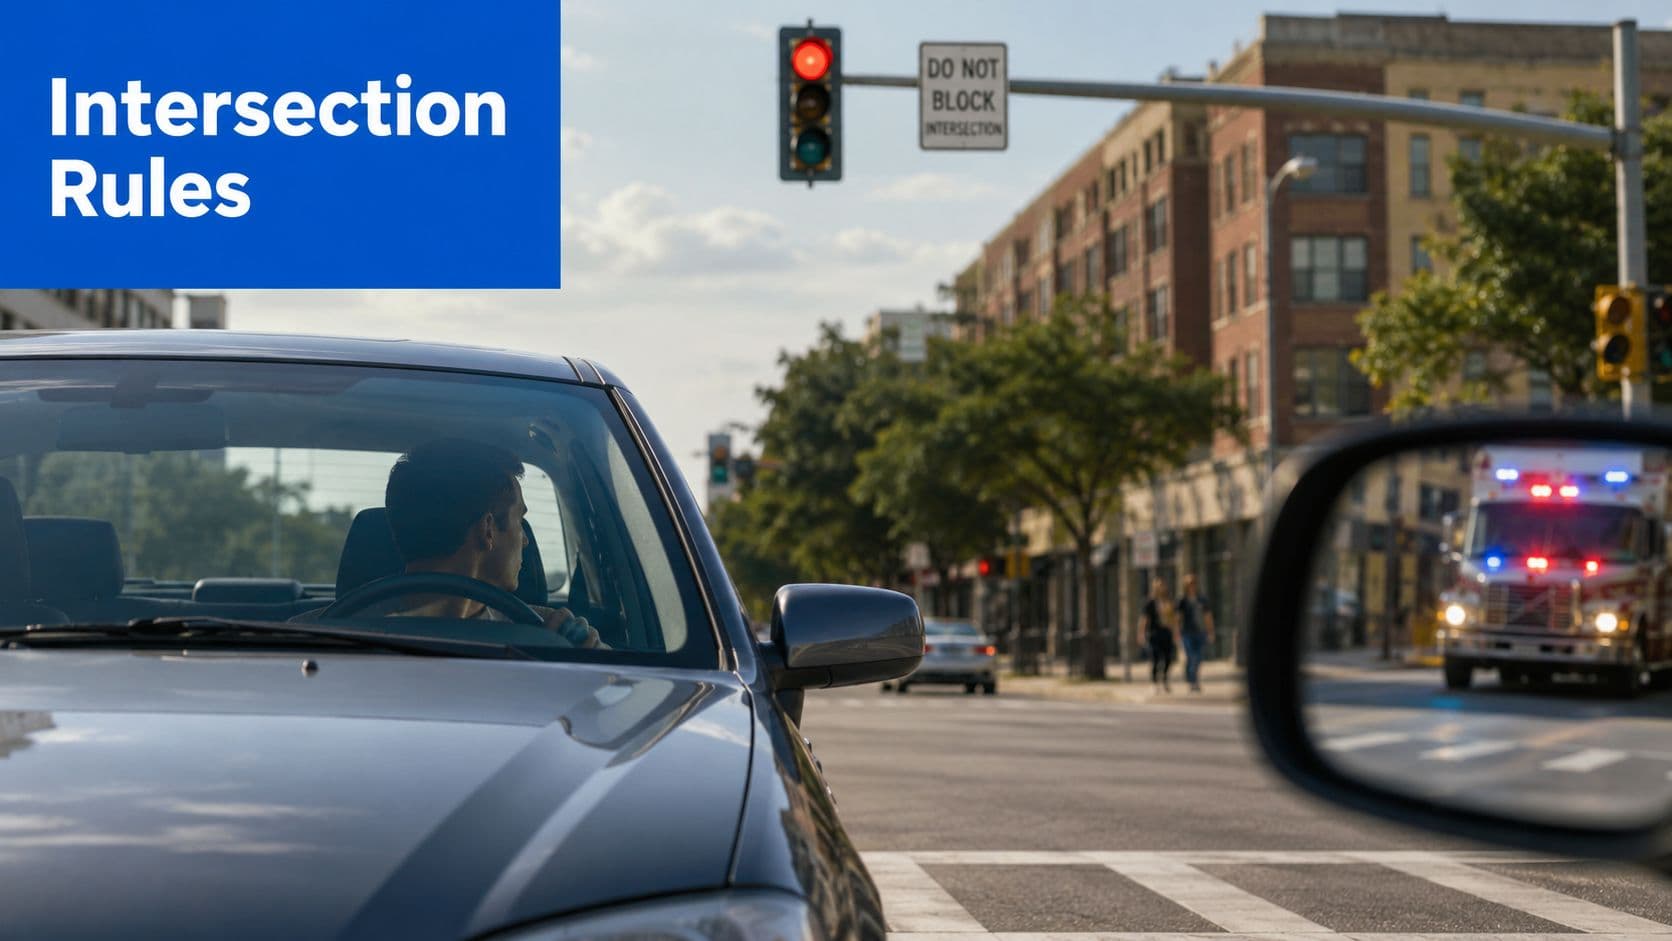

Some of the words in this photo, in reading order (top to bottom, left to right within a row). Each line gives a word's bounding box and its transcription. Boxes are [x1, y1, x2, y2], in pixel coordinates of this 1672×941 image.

[927, 58, 955, 79] DO
[962, 58, 1000, 79] NOT
[932, 90, 997, 111] BLOCK
[926, 121, 1003, 136] INTERSECTION
